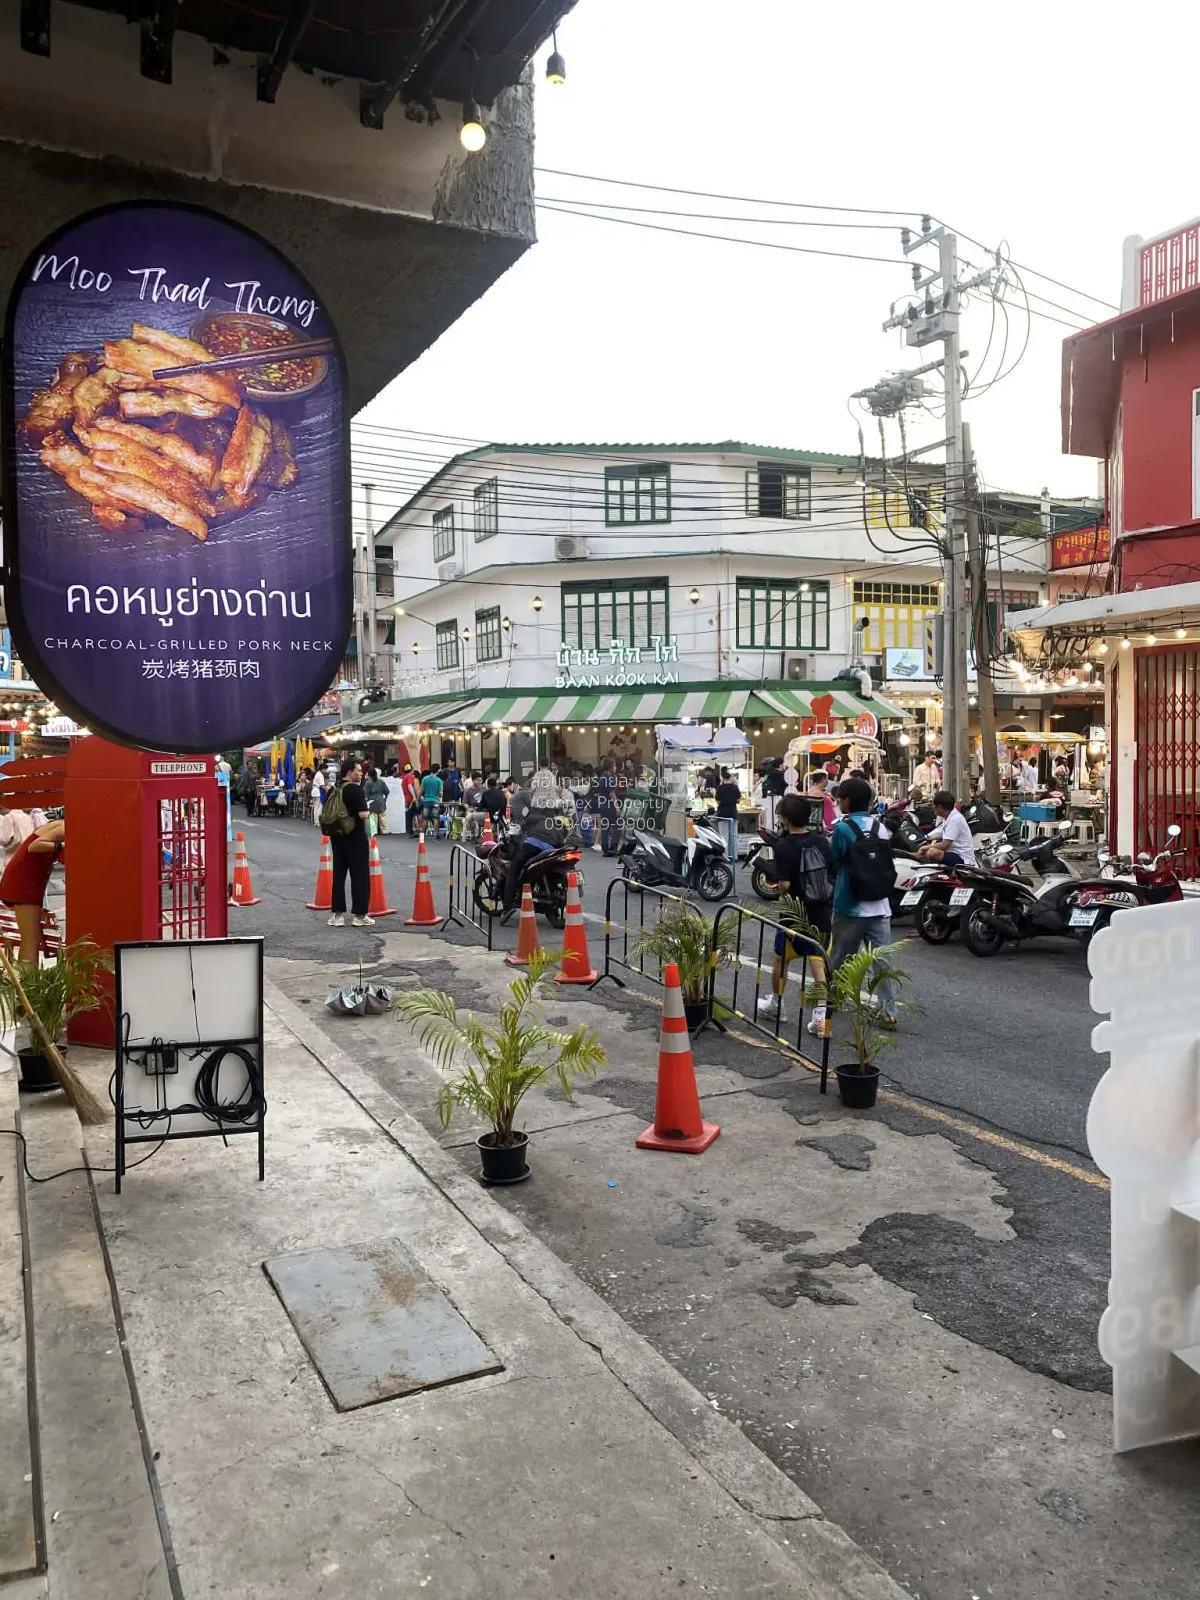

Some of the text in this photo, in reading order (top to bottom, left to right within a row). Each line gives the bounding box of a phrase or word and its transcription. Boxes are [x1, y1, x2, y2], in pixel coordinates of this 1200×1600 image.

[31, 254, 319, 328] Moo Thad Thong
[66, 576, 312, 627] คอหมูย่างถ่าน
[44, 637, 334, 651] CHARCOAL-GRILLED PORK NECK
[555, 642, 600, 667] บ้าน
[141, 659, 260, 679] 炭烤猪颈肉
[555, 672, 680, 689] BAAN KOOK KAI
[154, 763, 205, 773] TELEPHONE
